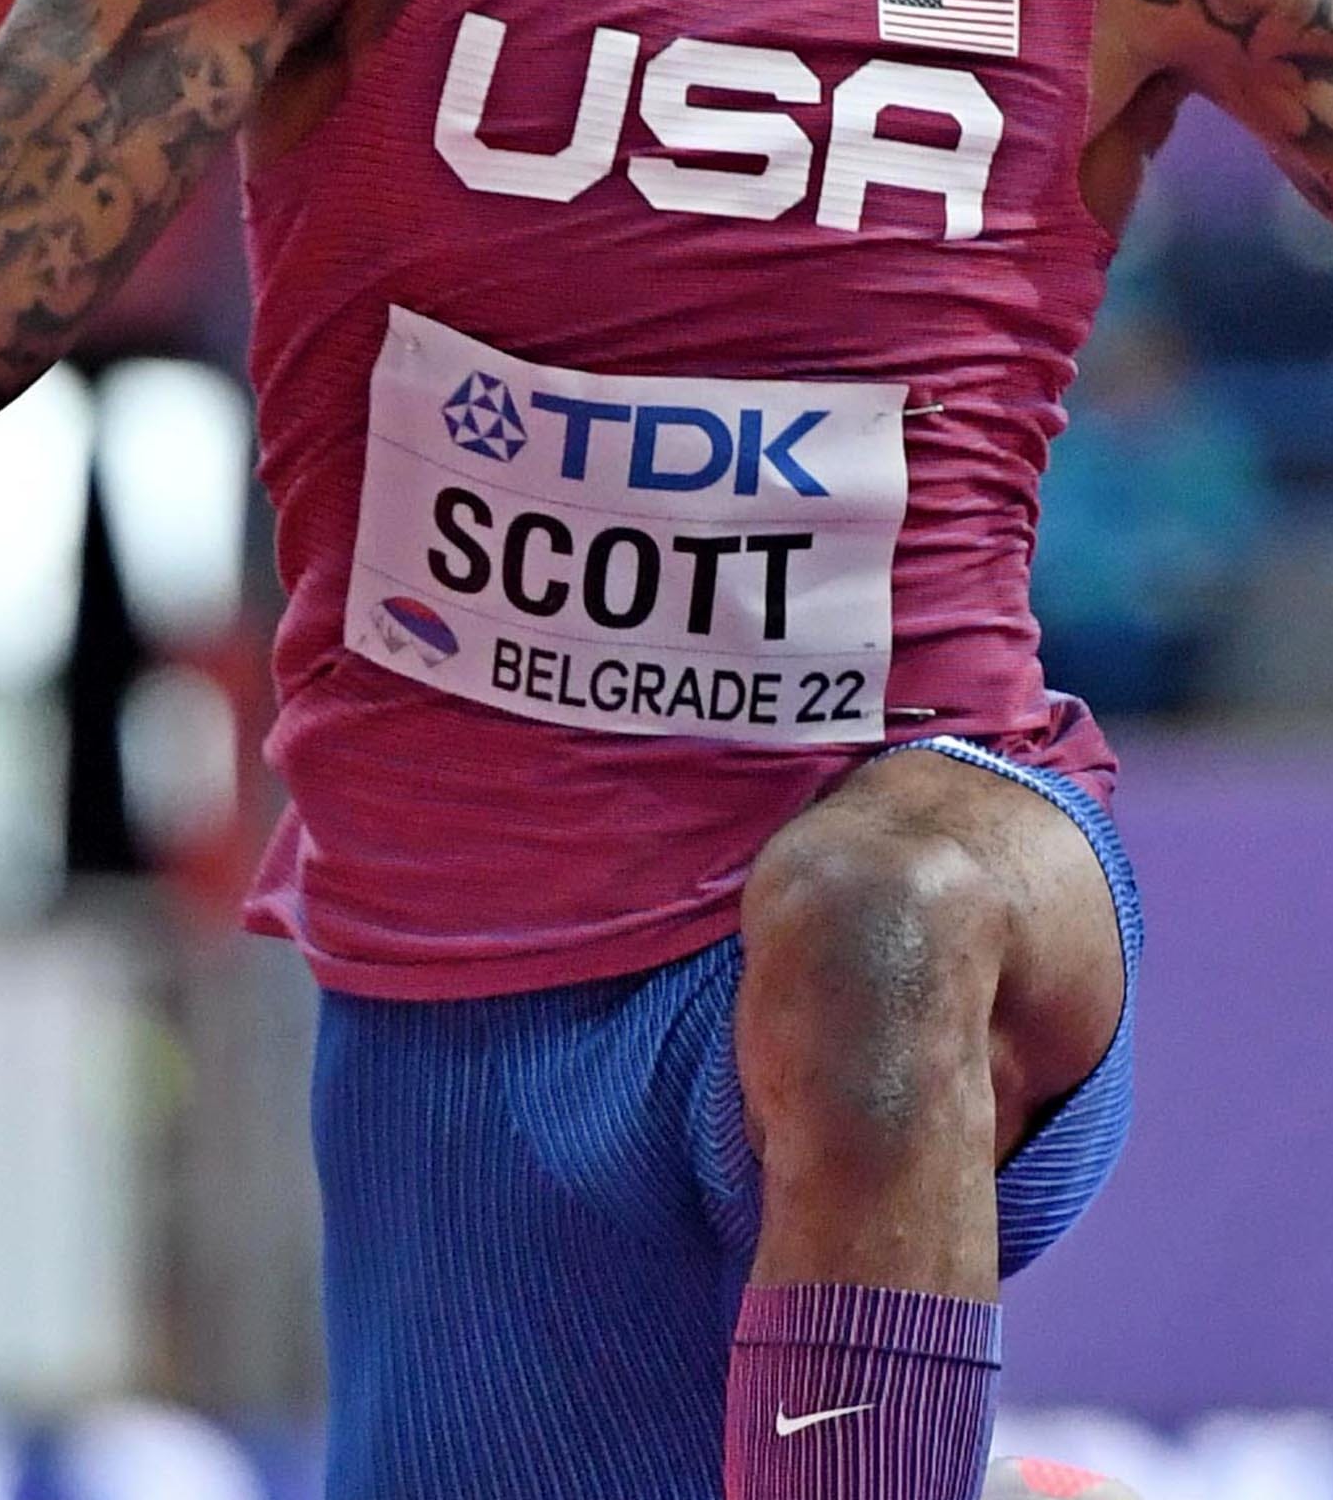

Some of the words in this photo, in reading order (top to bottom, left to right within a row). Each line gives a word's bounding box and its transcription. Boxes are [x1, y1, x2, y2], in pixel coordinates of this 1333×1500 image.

[434, 11, 1004, 240] USA
[531, 393, 830, 497] TDK
[427, 487, 813, 641] SCOTT
[491, 638, 782, 725] BELGRADE
[797, 670, 866, 723] 22
